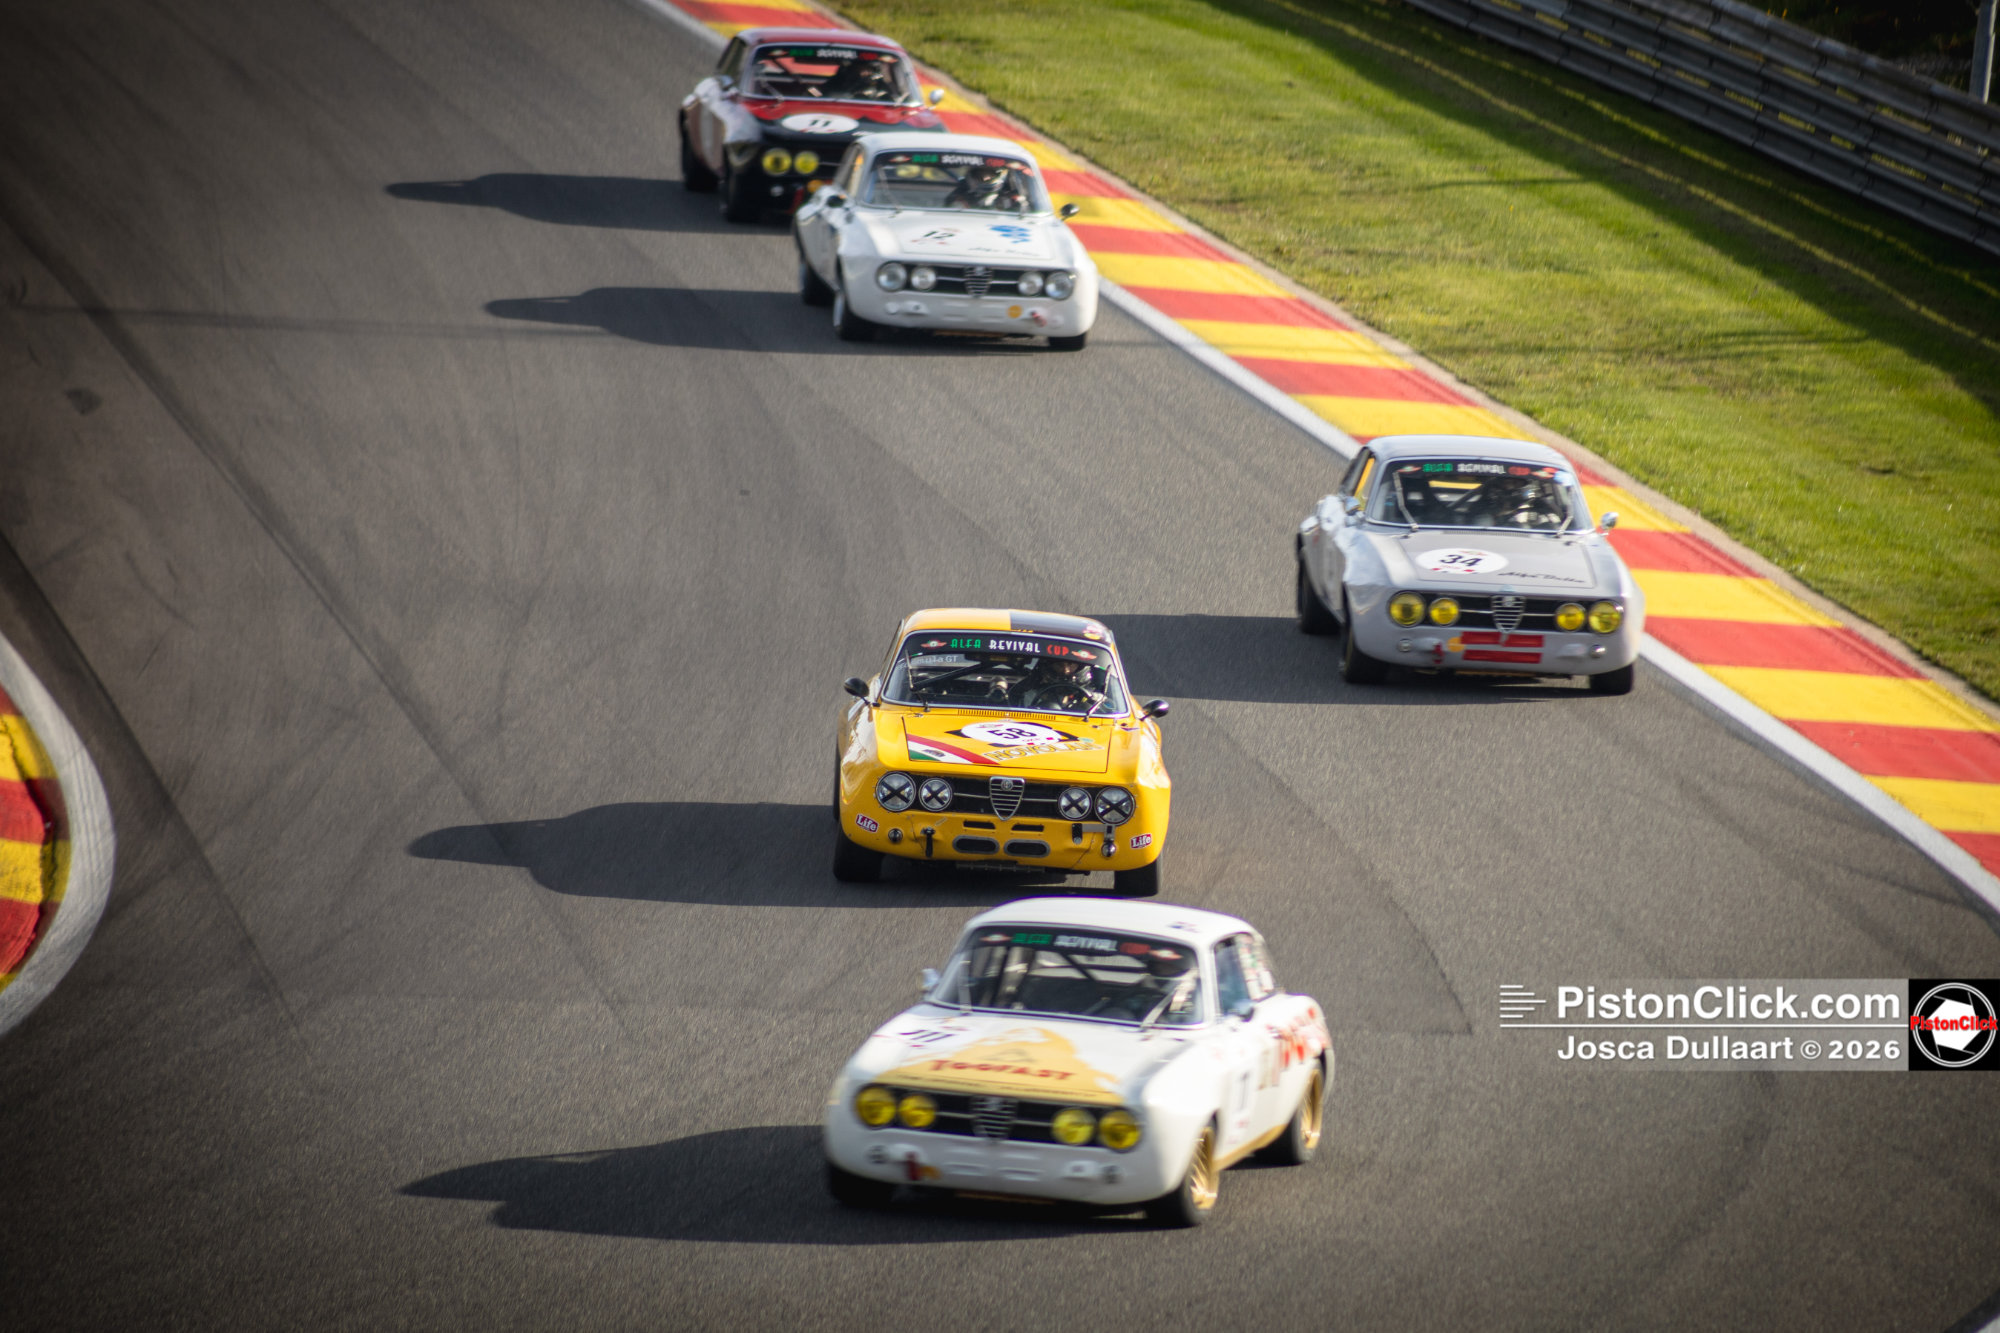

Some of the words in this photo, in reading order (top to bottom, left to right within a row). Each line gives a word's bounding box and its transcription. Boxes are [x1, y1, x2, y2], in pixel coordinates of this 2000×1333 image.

[1440, 554, 1482, 567] 34
[951, 638, 981, 649] ALFA
[988, 639, 1041, 653] REVIVAL
[1047, 644, 1069, 656] CUP
[987, 727, 1038, 740] 58
[857, 814, 877, 831] Life
[1132, 835, 1151, 848] Life
